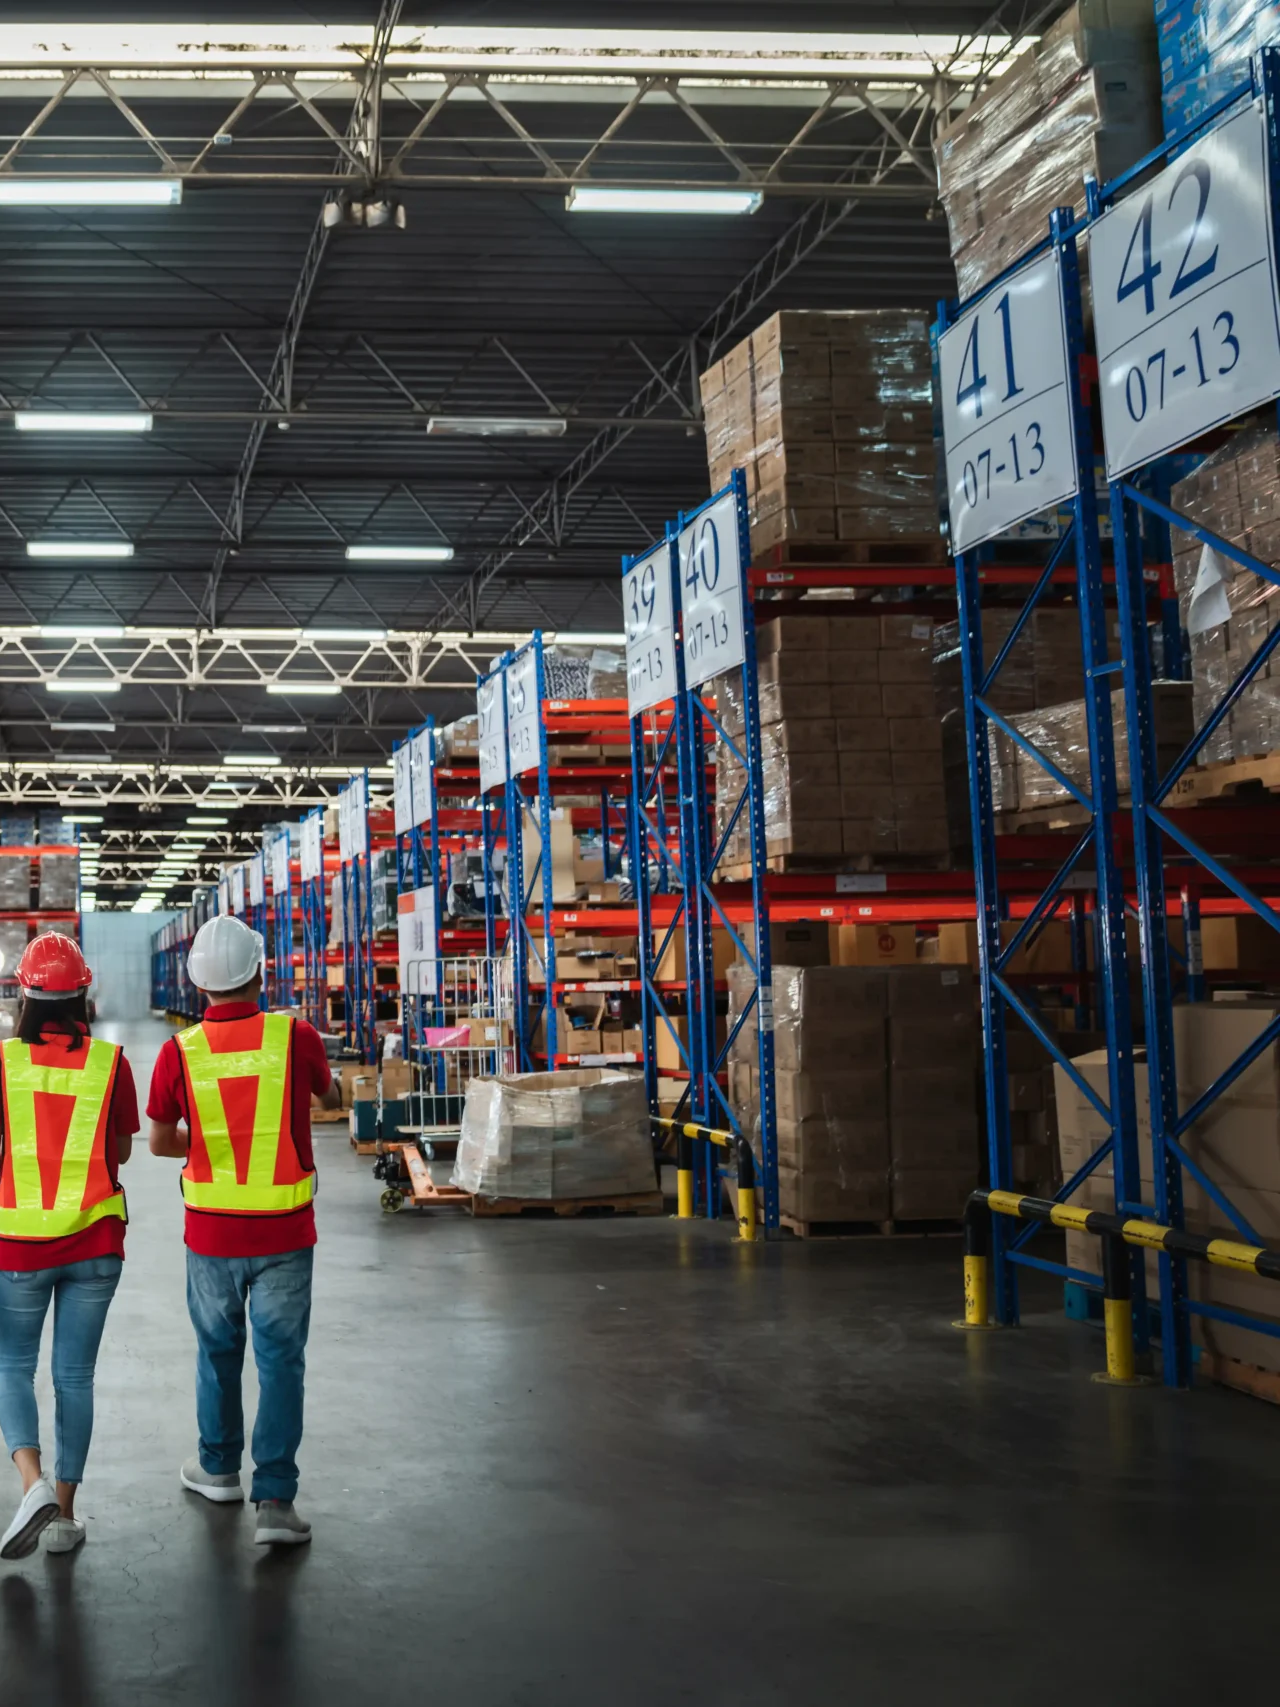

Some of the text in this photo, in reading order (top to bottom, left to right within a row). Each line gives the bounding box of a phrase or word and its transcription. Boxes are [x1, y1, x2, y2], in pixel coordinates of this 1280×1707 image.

[1116, 157, 1219, 315] 42
[956, 290, 1024, 419] 41
[1125, 310, 1240, 423] 07-13
[963, 421, 1045, 508] 07-13
[685, 517, 719, 600] 40
[628, 563, 655, 642] 39
[688, 610, 728, 660] 07-13
[630, 647, 663, 692] 07-13
